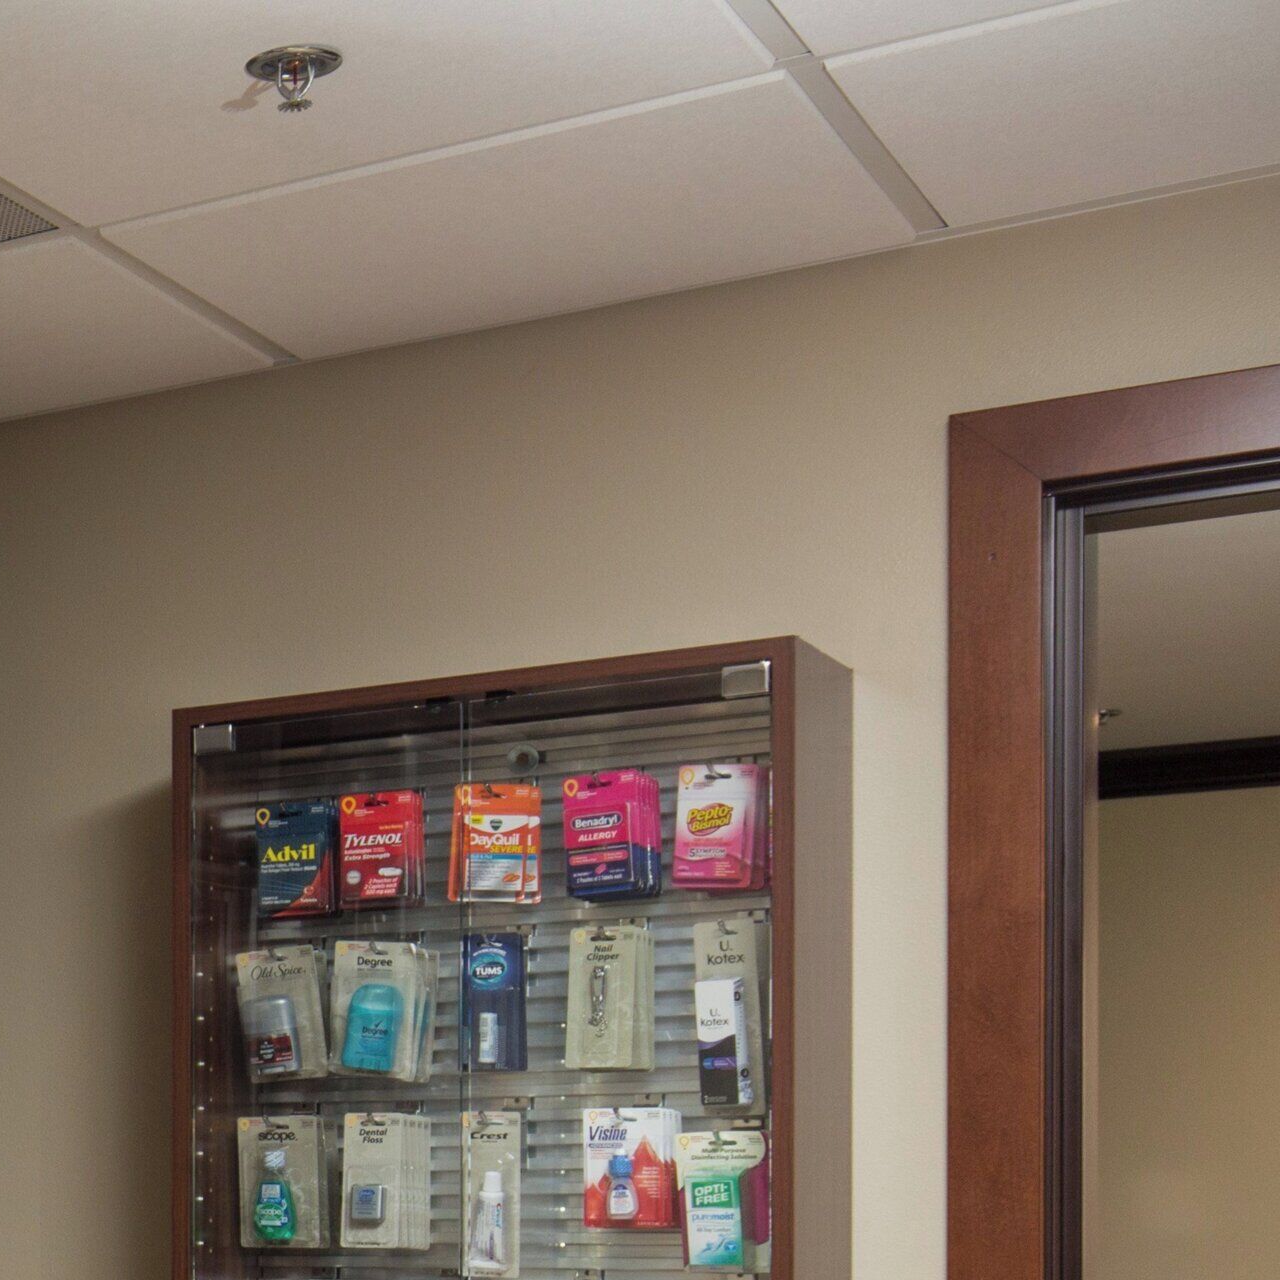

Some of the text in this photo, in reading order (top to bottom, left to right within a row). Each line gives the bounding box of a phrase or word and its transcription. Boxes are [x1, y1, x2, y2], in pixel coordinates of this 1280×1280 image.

[574, 814, 618, 829] Benadryl
[690, 814, 732, 832] Bismol
[344, 833, 402, 849] TYLENOL
[469, 833, 520, 848] DayQuil
[578, 830, 618, 842] ALLERGY
[261, 842, 316, 863] Advil
[489, 844, 523, 853] SEVERE
[594, 944, 614, 953] Nail
[357, 956, 393, 969] Degree
[586, 953, 620, 962] Clipper
[707, 953, 745, 966] kotex
[251, 963, 303, 980] Old Spice
[475, 966, 503, 976] TUMS
[700, 1016, 729, 1027] kotex
[362, 1025, 389, 1036] Degree
[359, 1127, 388, 1137] Dental
[470, 1131, 509, 1140] Crest
[589, 1125, 628, 1141] Visine
[362, 1136, 384, 1145] Floss
[694, 1183, 729, 1197] OPTI-
[695, 1192, 729, 1206] FREE
